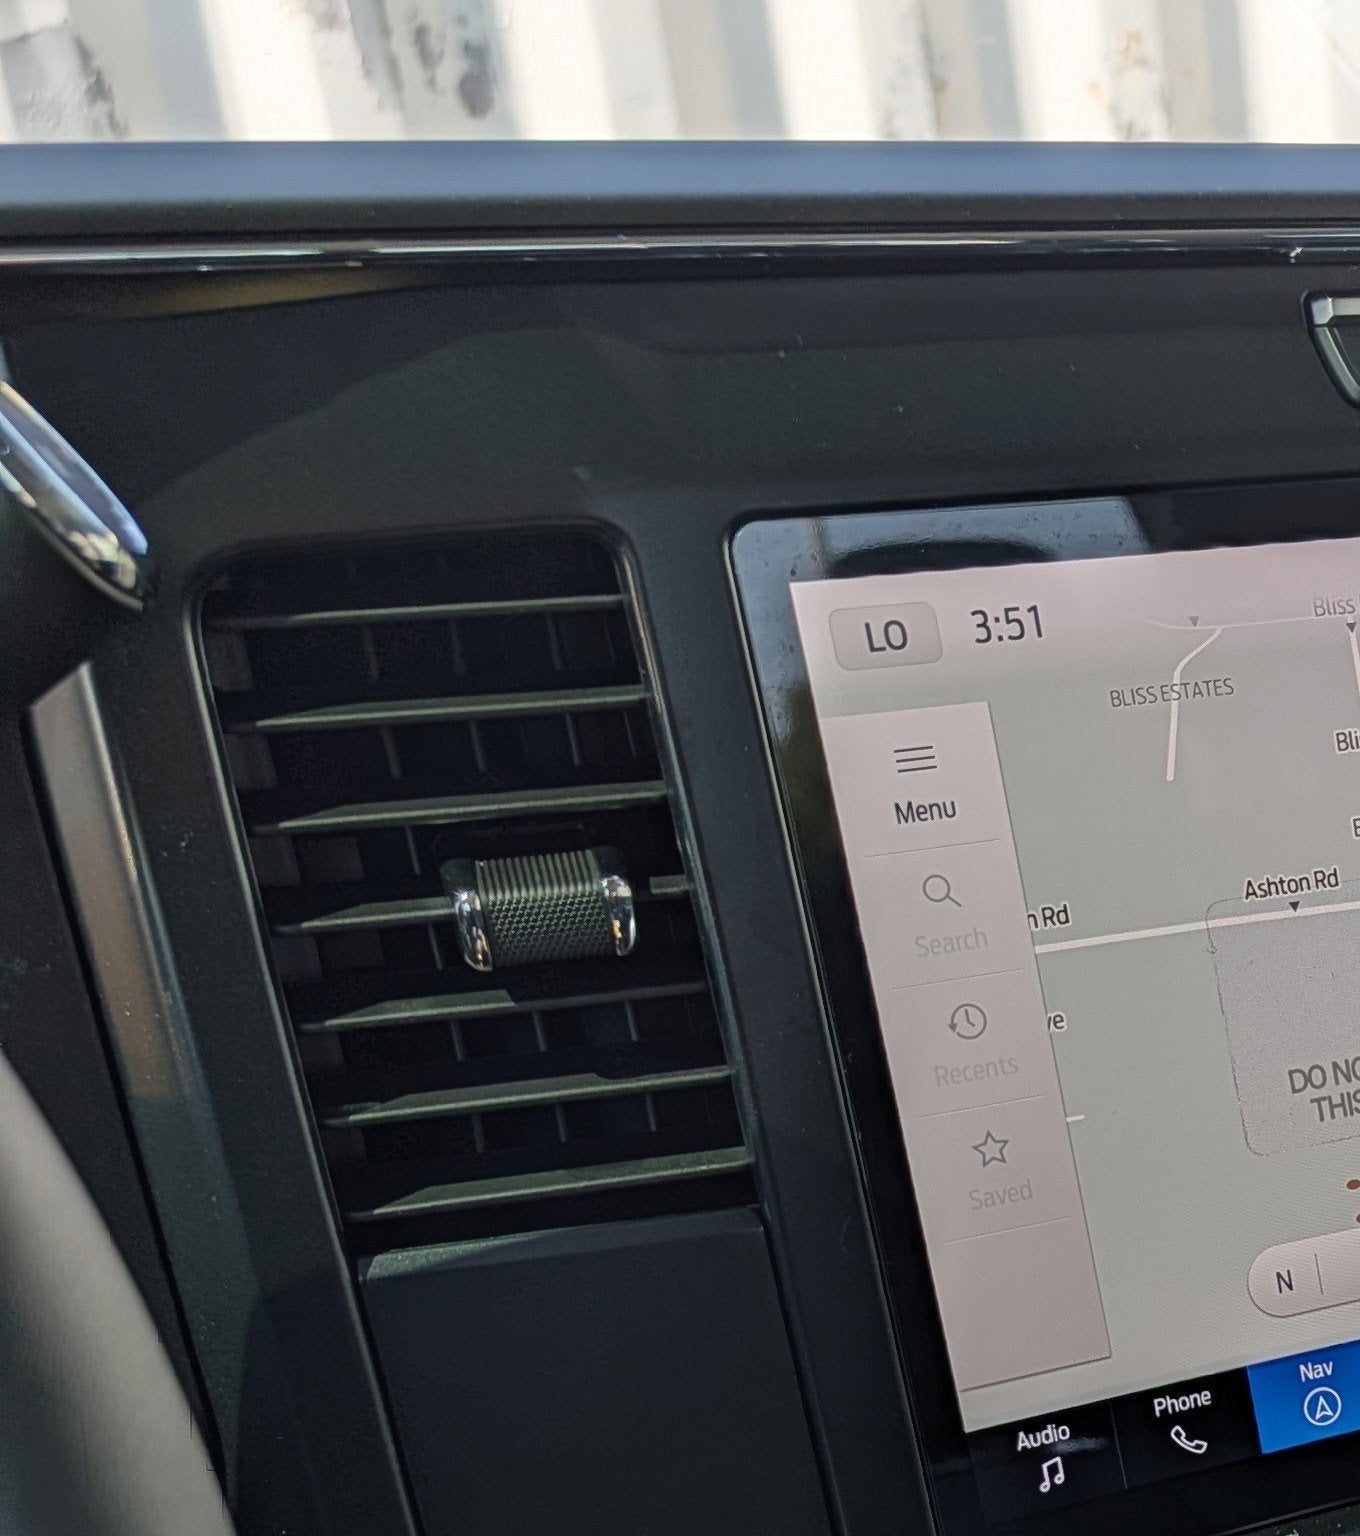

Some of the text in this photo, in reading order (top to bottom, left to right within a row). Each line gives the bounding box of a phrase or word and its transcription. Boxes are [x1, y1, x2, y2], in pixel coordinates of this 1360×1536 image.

[1312, 594, 1355, 618] Bliss
[864, 619, 908, 653] LO
[970, 604, 1044, 646] 3:51
[1109, 677, 1235, 708] BLISS ESTATES
[894, 798, 957, 826] Menu
[1243, 868, 1340, 901] Ashton Rd
[1041, 904, 1070, 928] Rd
[914, 927, 989, 957] Search
[933, 1054, 1020, 1088] Recents
[1287, 1062, 1330, 1096] DO
[968, 1180, 1034, 1211] Saved
[1275, 1269, 1295, 1295] N
[1299, 1358, 1335, 1382] Nav
[1153, 1388, 1213, 1417] Phone
[1016, 1422, 1071, 1452] Audio
